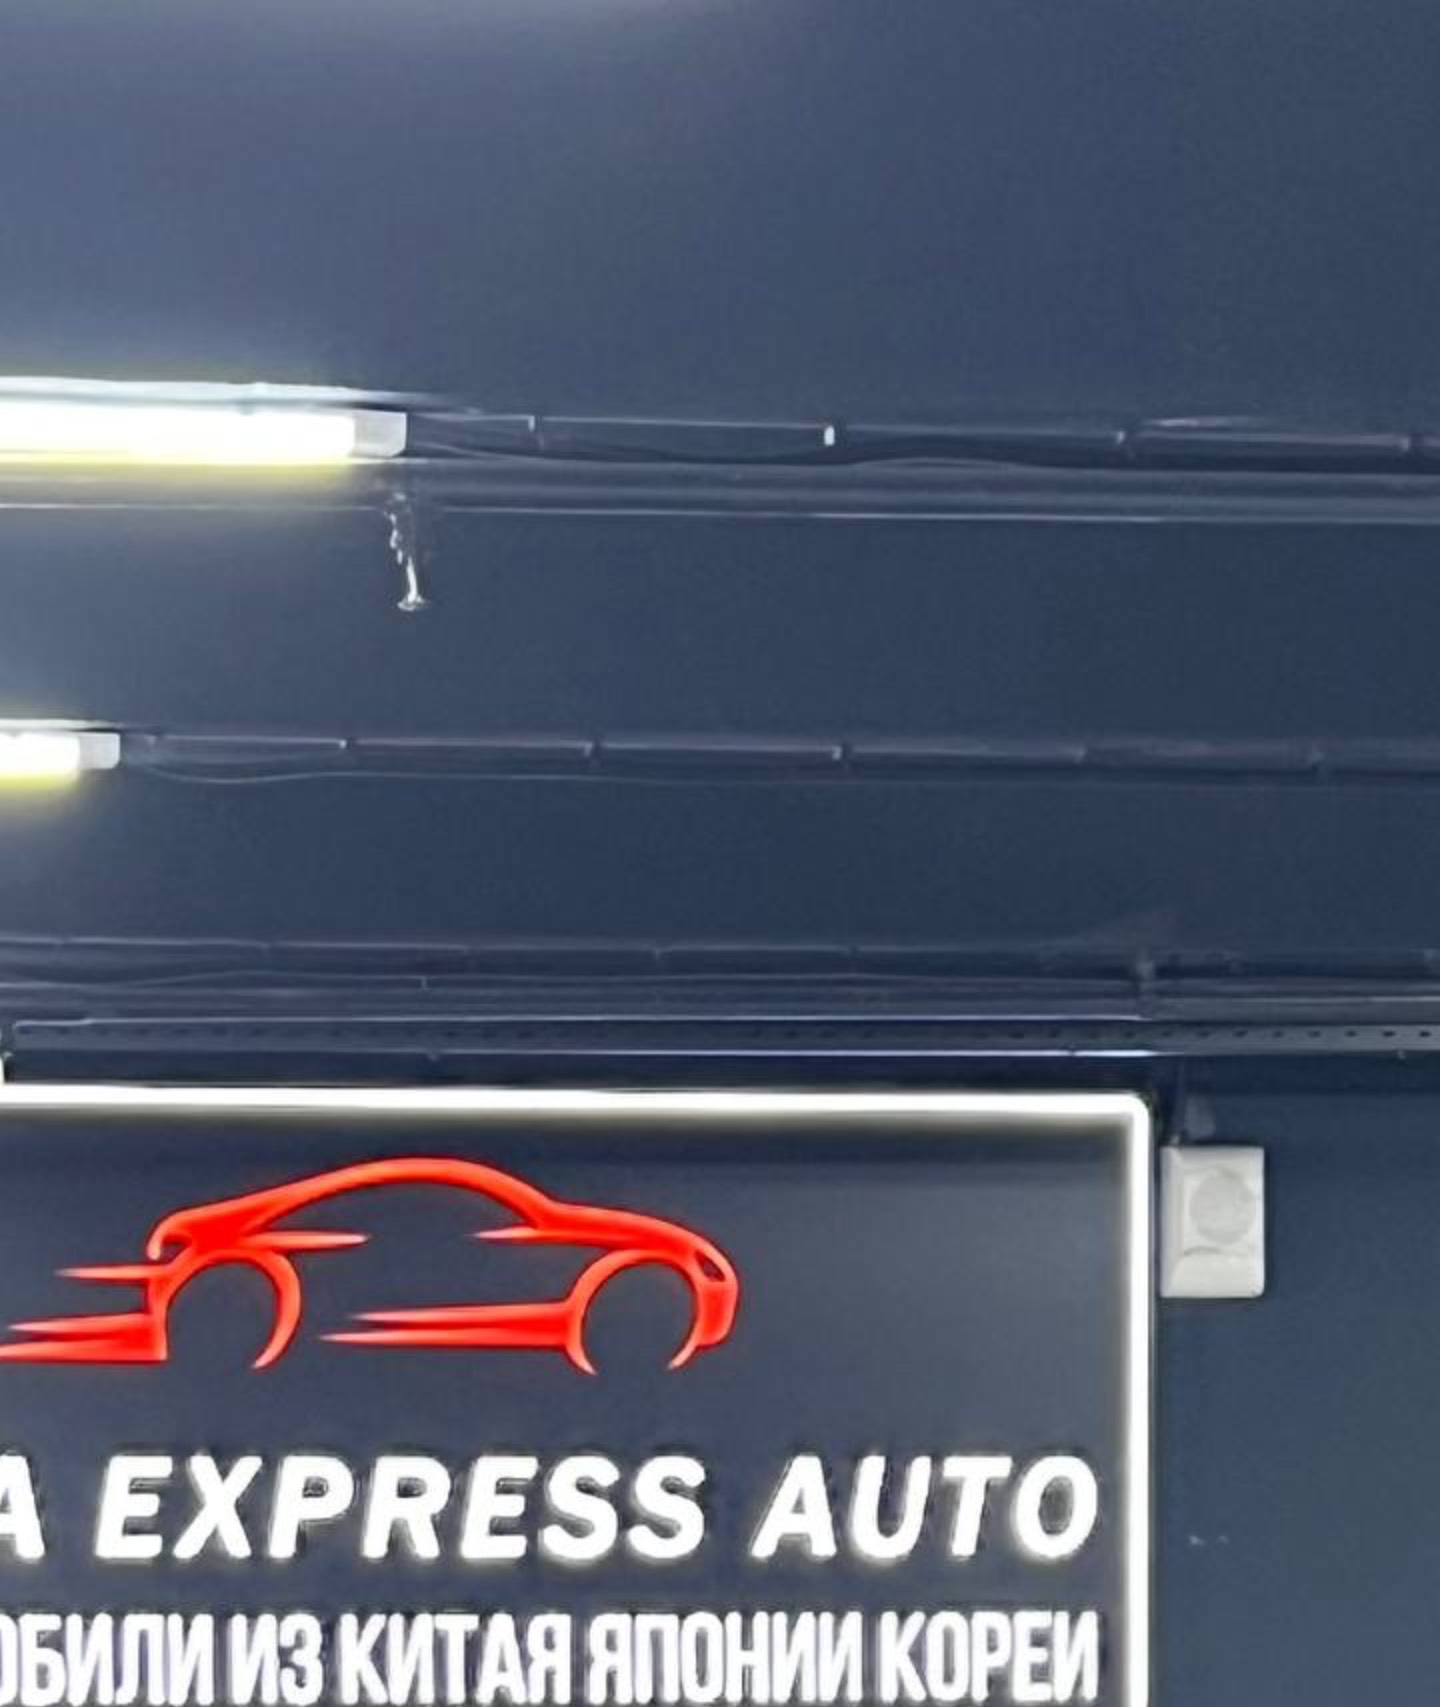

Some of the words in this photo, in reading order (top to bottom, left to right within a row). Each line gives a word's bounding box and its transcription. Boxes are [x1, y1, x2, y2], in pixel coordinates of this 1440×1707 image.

[94, 1455, 706, 1560] EXPRESS
[752, 1456, 1098, 1560] AUTO
[229, 1612, 324, 1707] ИЗ
[340, 1612, 572, 1705] КИТАЯ
[588, 1611, 863, 1705] ЯПОНИИ
[879, 1610, 1099, 1703] КОРЕИ
